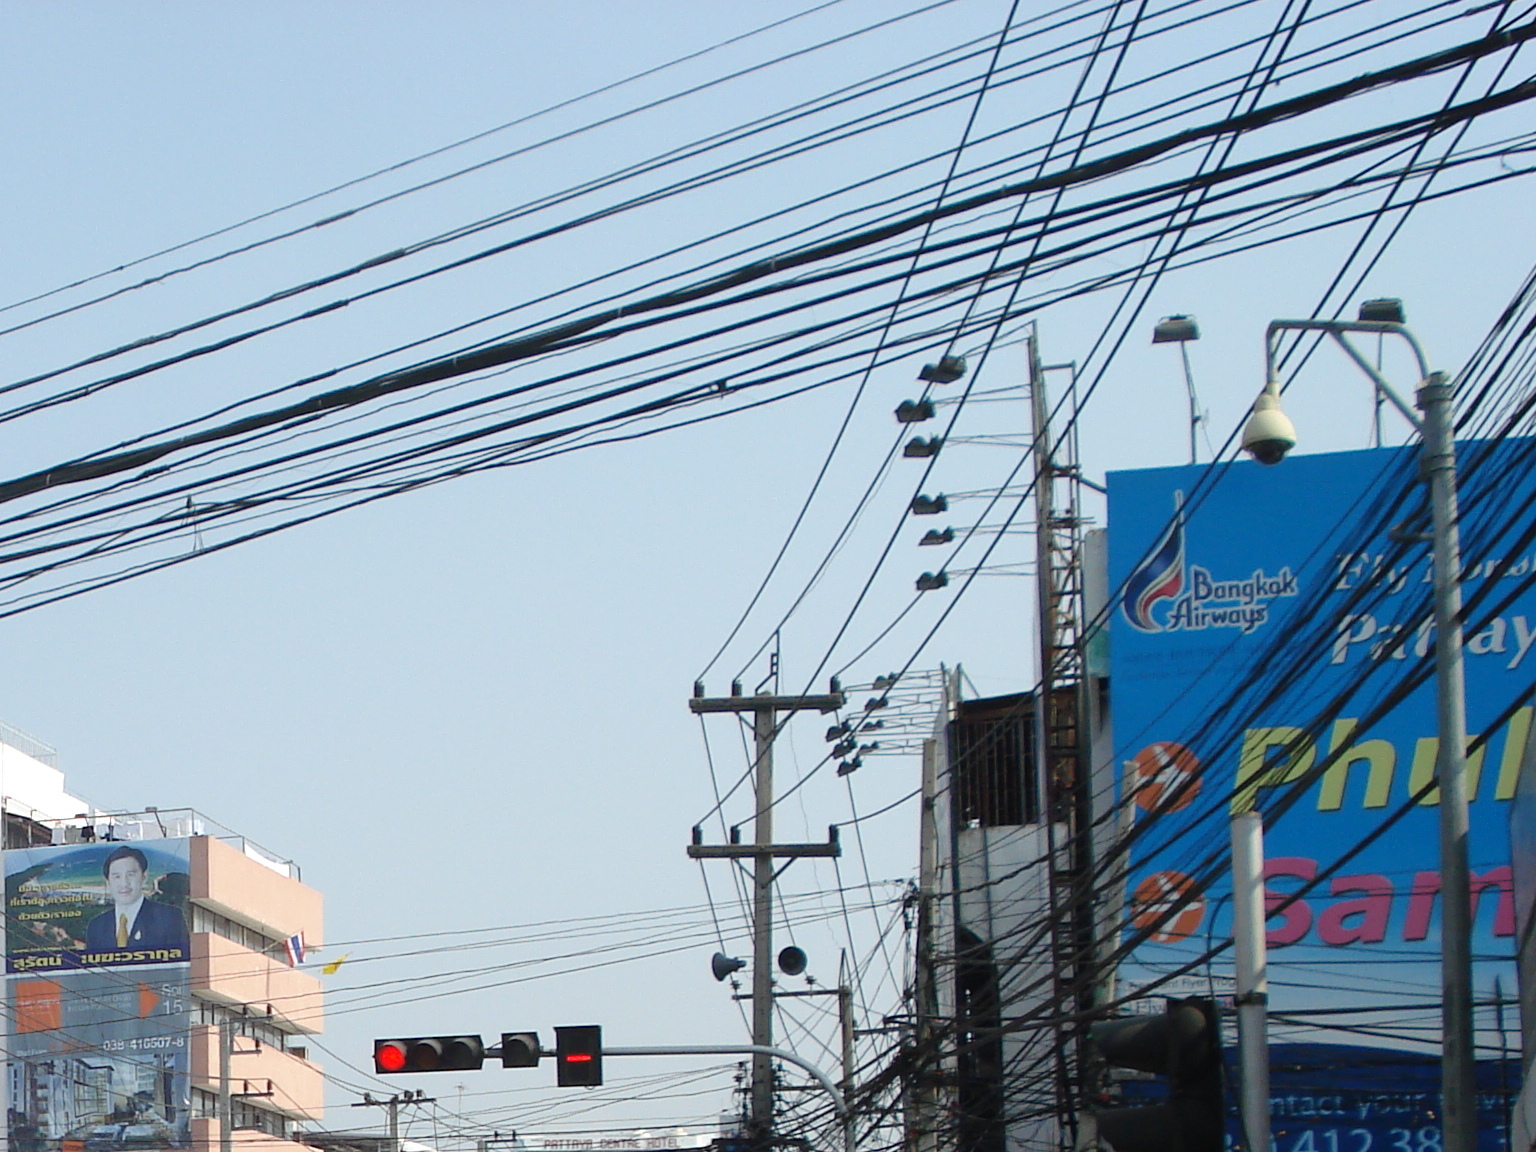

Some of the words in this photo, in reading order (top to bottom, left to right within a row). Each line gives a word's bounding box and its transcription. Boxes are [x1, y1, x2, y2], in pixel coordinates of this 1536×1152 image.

[1192, 564, 1298, 605] Bangkok
[1167, 594, 1268, 634] Airways
[1331, 612, 1536, 670] Patay
[163, 999, 184, 1016] 15
